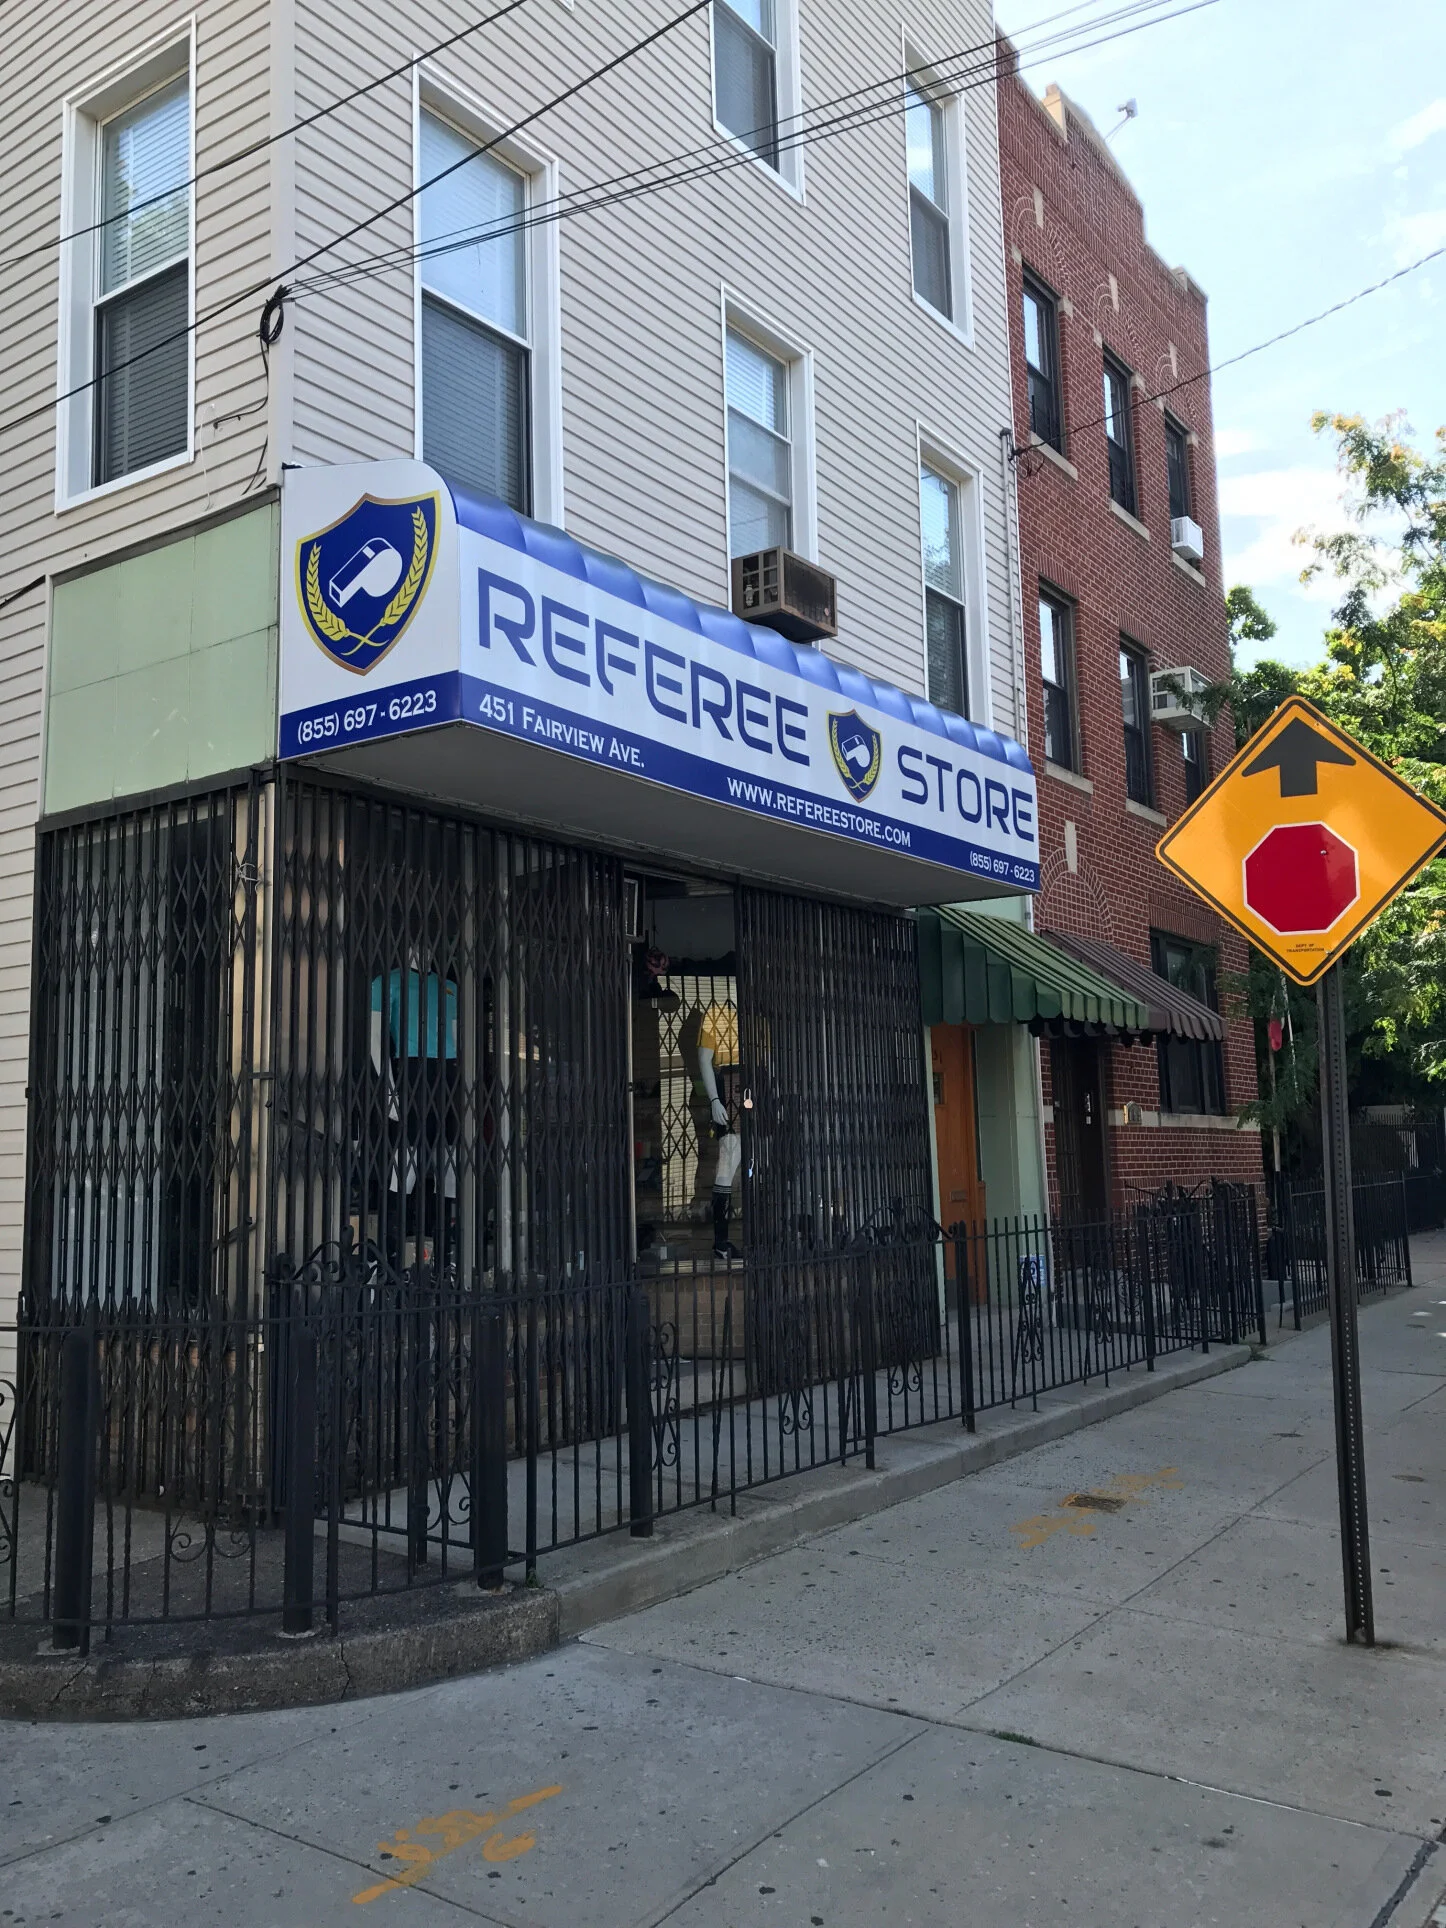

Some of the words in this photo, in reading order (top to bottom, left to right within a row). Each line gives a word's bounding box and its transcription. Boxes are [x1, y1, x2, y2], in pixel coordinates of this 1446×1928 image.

[477, 566, 811, 767] REFEREE
[897, 744, 1035, 843] STORE
[479, 693, 514, 726] 451
[297, 711, 340, 745] (855)
[726, 776, 912, 848] WWW.REFEREESTORE.COM
[969, 850, 992, 872] (855)
